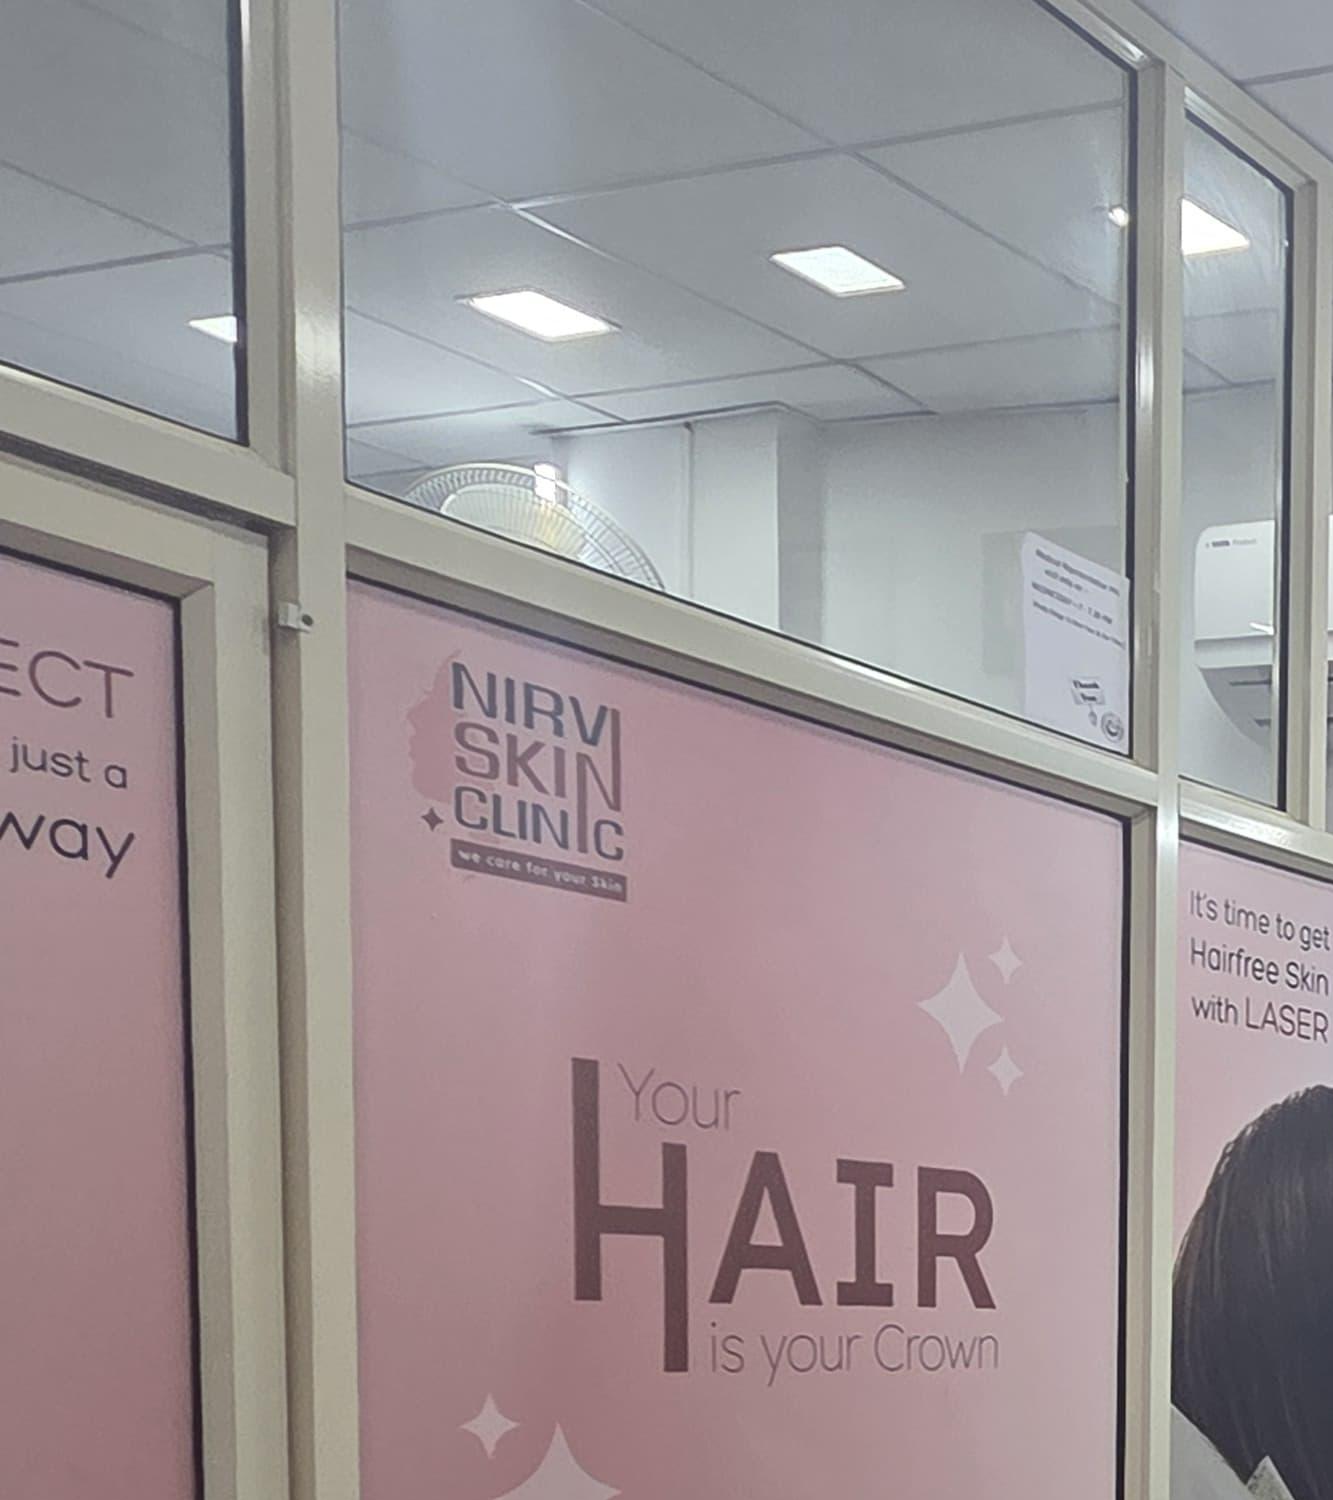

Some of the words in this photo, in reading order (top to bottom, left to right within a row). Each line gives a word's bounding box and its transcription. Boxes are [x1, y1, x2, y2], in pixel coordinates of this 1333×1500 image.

[452, 661, 608, 747] NIRV
[9, 736, 91, 783] just
[104, 764, 128, 789] a
[454, 708, 622, 812] SKIN
[454, 785, 625, 862] CLINIC
[458, 850, 481, 864] we
[486, 855, 521, 872] care
[526, 861, 549, 877] for
[1190, 890, 1218, 921] It's
[1224, 899, 1270, 934] time
[1275, 913, 1295, 941] to
[1300, 925, 1330, 951] get
[1191, 937, 1279, 985] Hairfree
[1285, 961, 1329, 996] Skin
[1192, 995, 1238, 1026] with
[1246, 997, 1329, 1043] LASER
[618, 1062, 741, 1132] Your
[571, 1057, 997, 1373] HAIR
[710, 1321, 744, 1373] is
[760, 1333, 862, 1388] your
[873, 1323, 999, 1373] Crown
